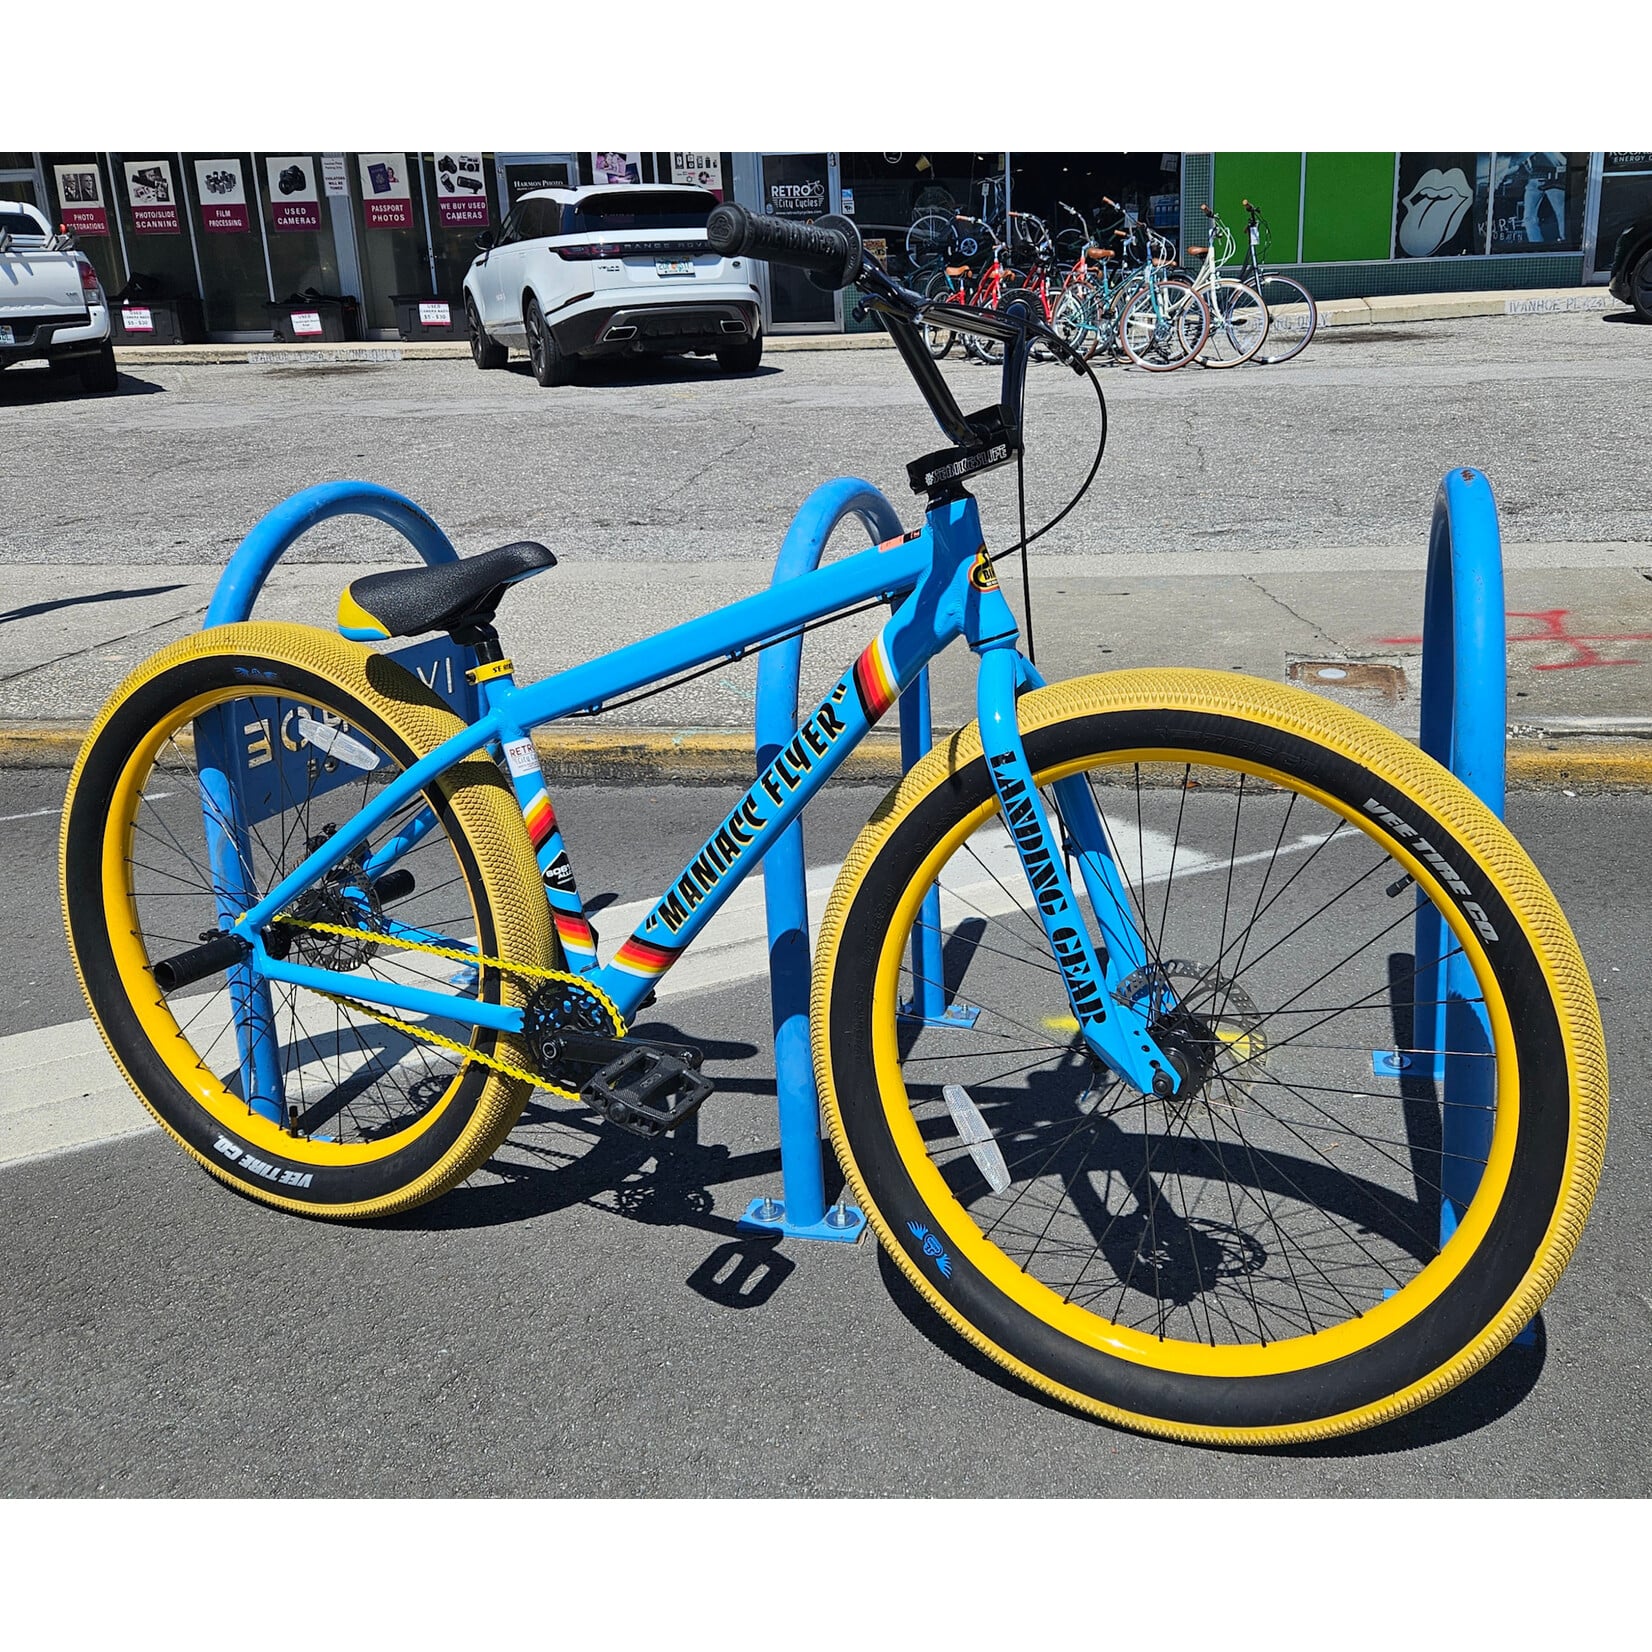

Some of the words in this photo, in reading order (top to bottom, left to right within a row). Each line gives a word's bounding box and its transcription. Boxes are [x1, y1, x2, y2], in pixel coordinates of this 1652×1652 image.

[771, 184, 810, 196] RETRO
[779, 198, 794, 209] City
[795, 198, 818, 208] Cycles
[135, 210, 175, 219] PHOTO/SLIDE
[372, 214, 406, 222] PHOTOS
[446, 212, 482, 220] CAMERAS
[136, 220, 178, 228] SCANNING
[209, 219, 242, 228] PROCESSING
[1509, 300, 1560, 313] IVANHOE
[510, 743, 536, 758] RETR
[1362, 798, 1418, 838] VEE
[1412, 837, 1472, 896] TIRE
[1462, 900, 1500, 944] CO.
[990, 750, 1068, 916] LANDING
[1052, 926, 1106, 1028] GEAR
[213, 1134, 244, 1160] CO.
[238, 1154, 282, 1182] TIRE
[278, 1170, 314, 1188] VEE
